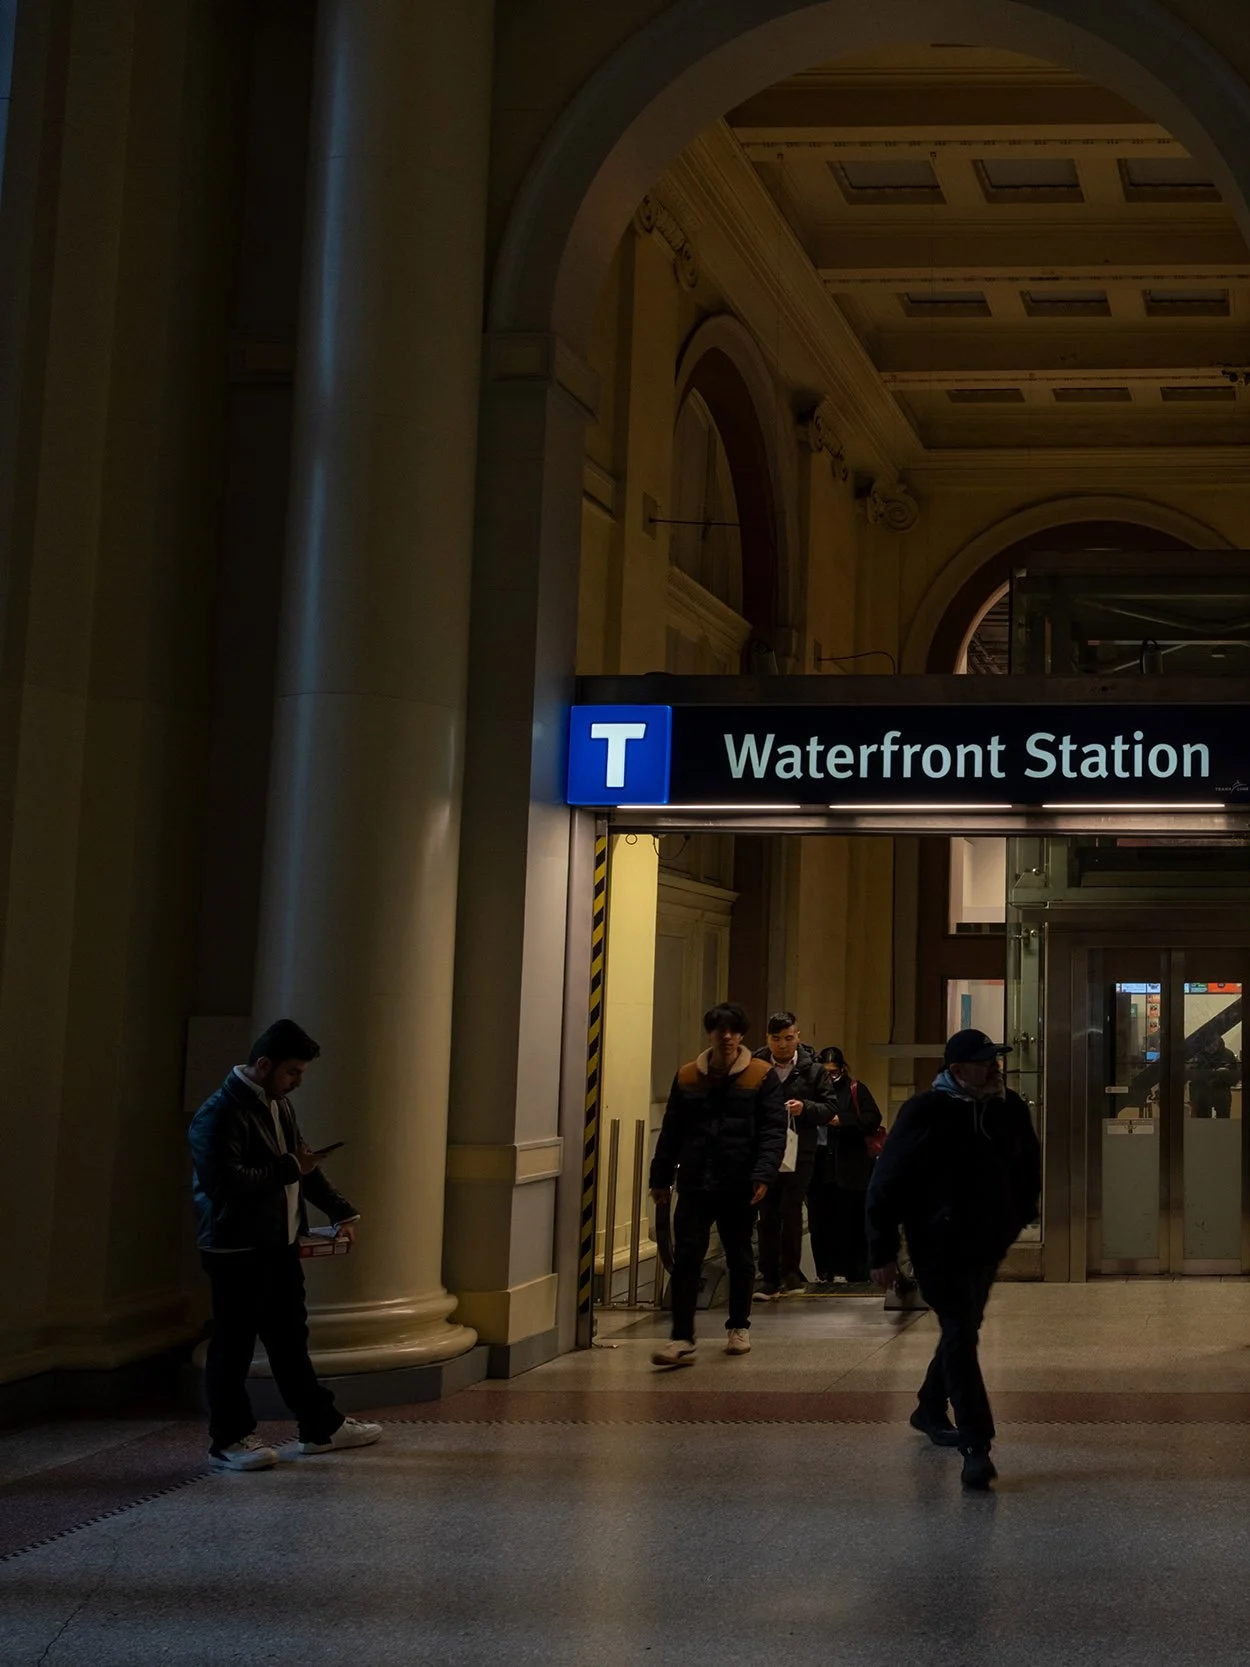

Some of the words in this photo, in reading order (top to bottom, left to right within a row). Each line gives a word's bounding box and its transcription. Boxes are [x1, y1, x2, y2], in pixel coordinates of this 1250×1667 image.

[590, 723, 647, 787] T
[724, 730, 1006, 779] Waterfront
[1024, 730, 1210, 779] Station
